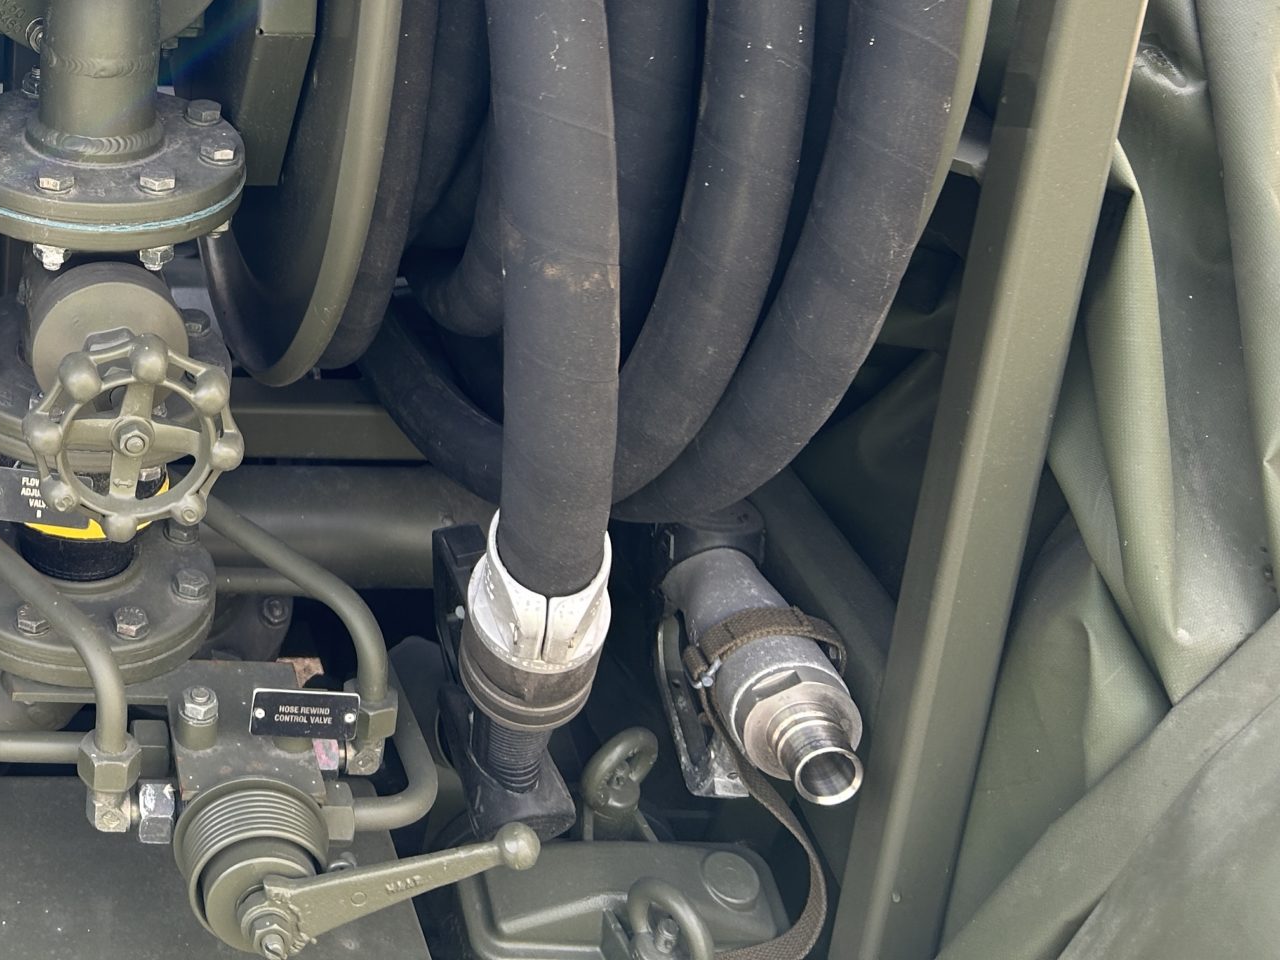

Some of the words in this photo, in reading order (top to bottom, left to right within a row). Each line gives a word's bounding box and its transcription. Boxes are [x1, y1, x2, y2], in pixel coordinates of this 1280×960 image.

[278, 705, 299, 714] HOSE
[300, 706, 330, 715] REWIND
[274, 714, 308, 724] CONTROL
[310, 716, 333, 724] VALVE
